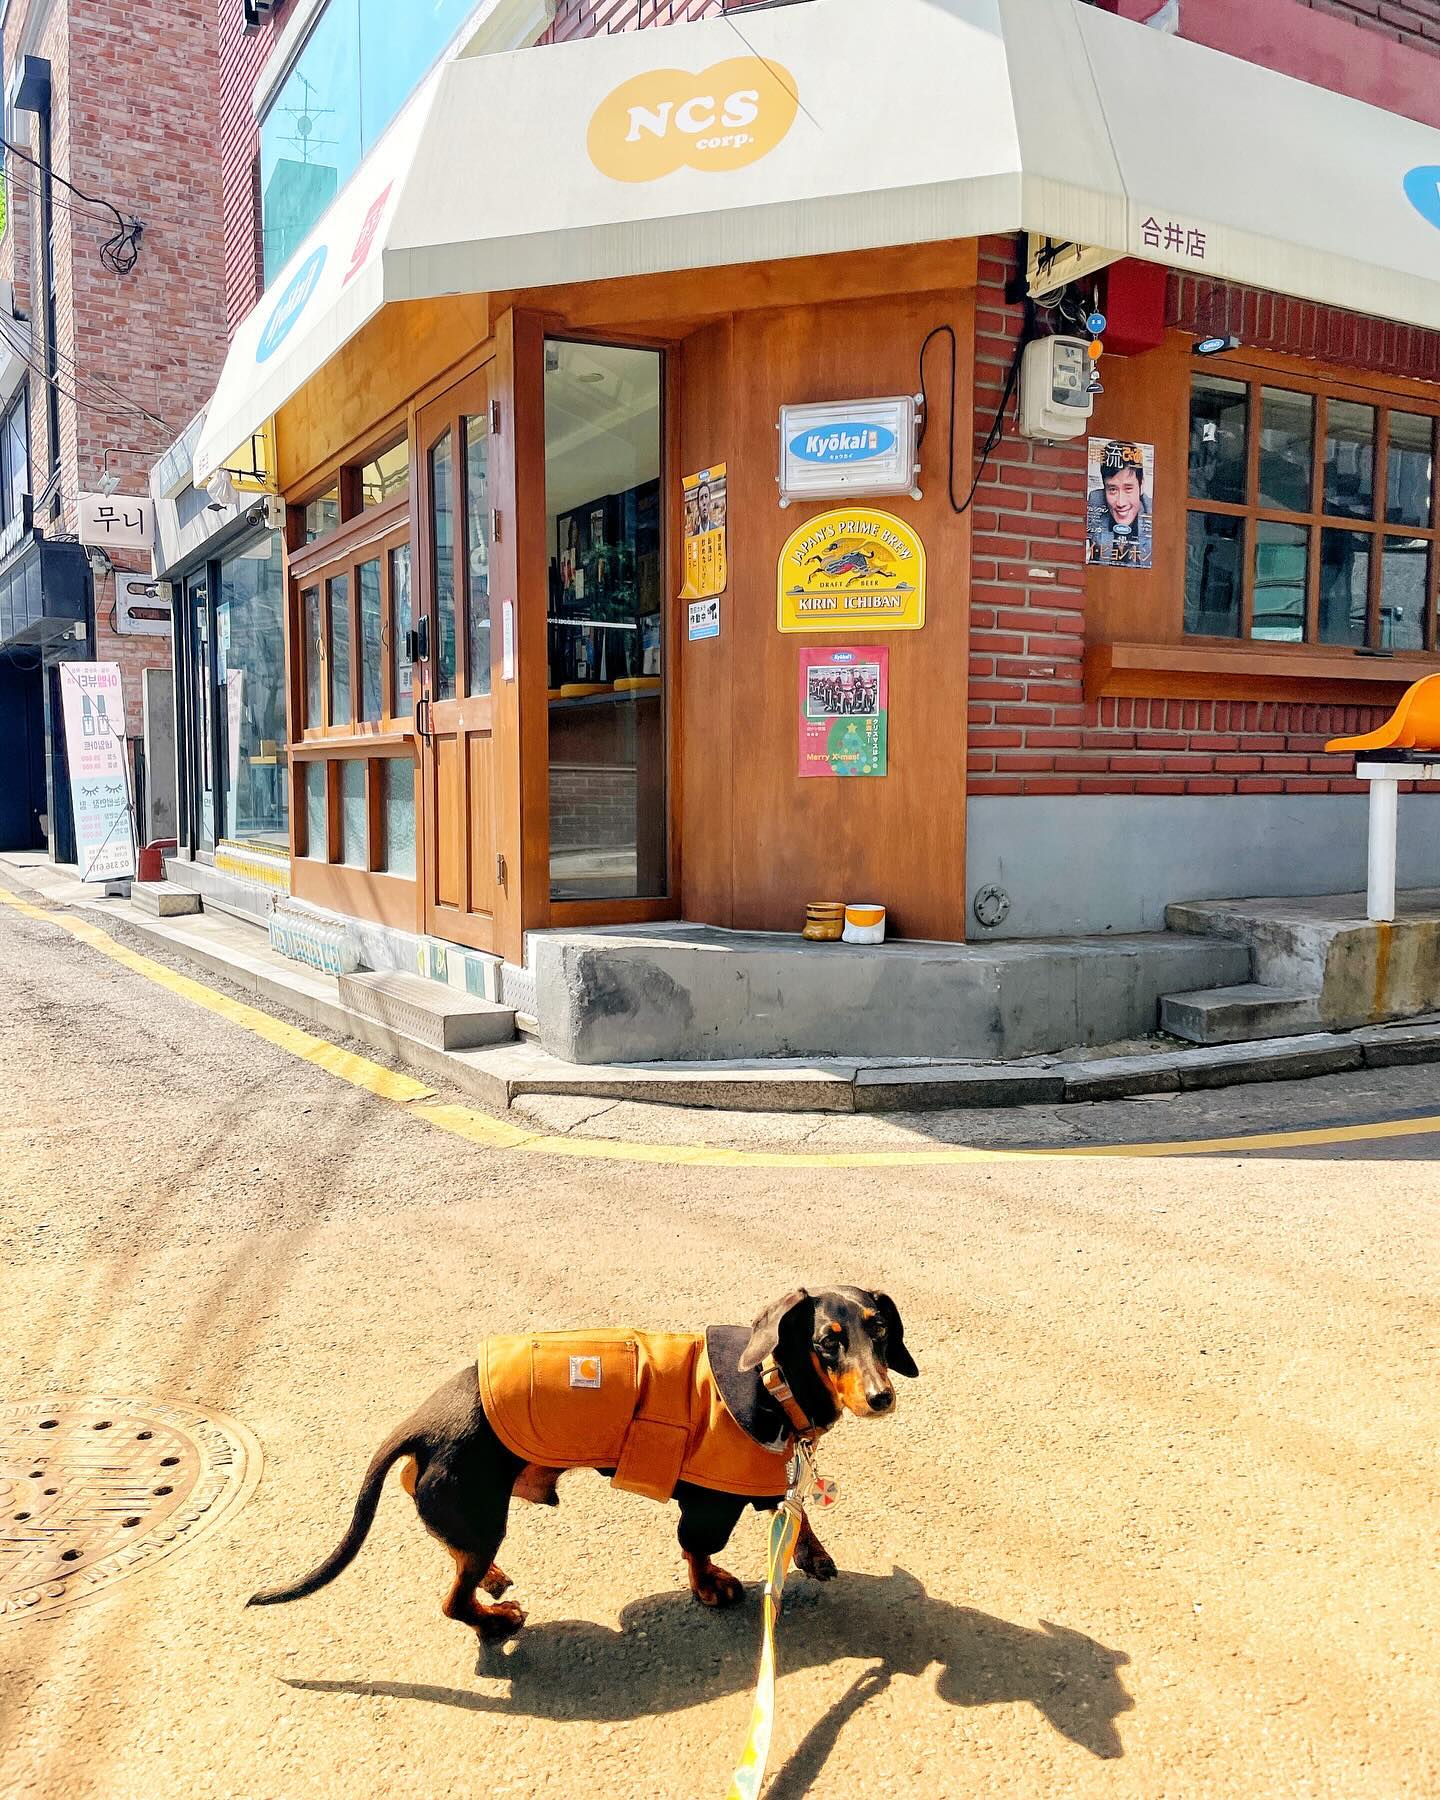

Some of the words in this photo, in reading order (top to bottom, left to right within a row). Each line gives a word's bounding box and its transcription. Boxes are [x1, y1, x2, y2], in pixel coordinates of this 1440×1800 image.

[625, 90, 759, 142] NCS
[696, 133, 754, 150] corp.
[1141, 217, 1206, 259] 合井店
[806, 430, 868, 456] Kyōkai
[93, 507, 144, 535] 무니
[791, 525, 836, 566] JAPAN'S
[838, 520, 880, 537] PRIME
[880, 530, 913, 560] BREW
[800, 597, 837, 610] KIRIN
[844, 595, 901, 608] ICHIBAN
[807, 754, 829, 762] Merry
